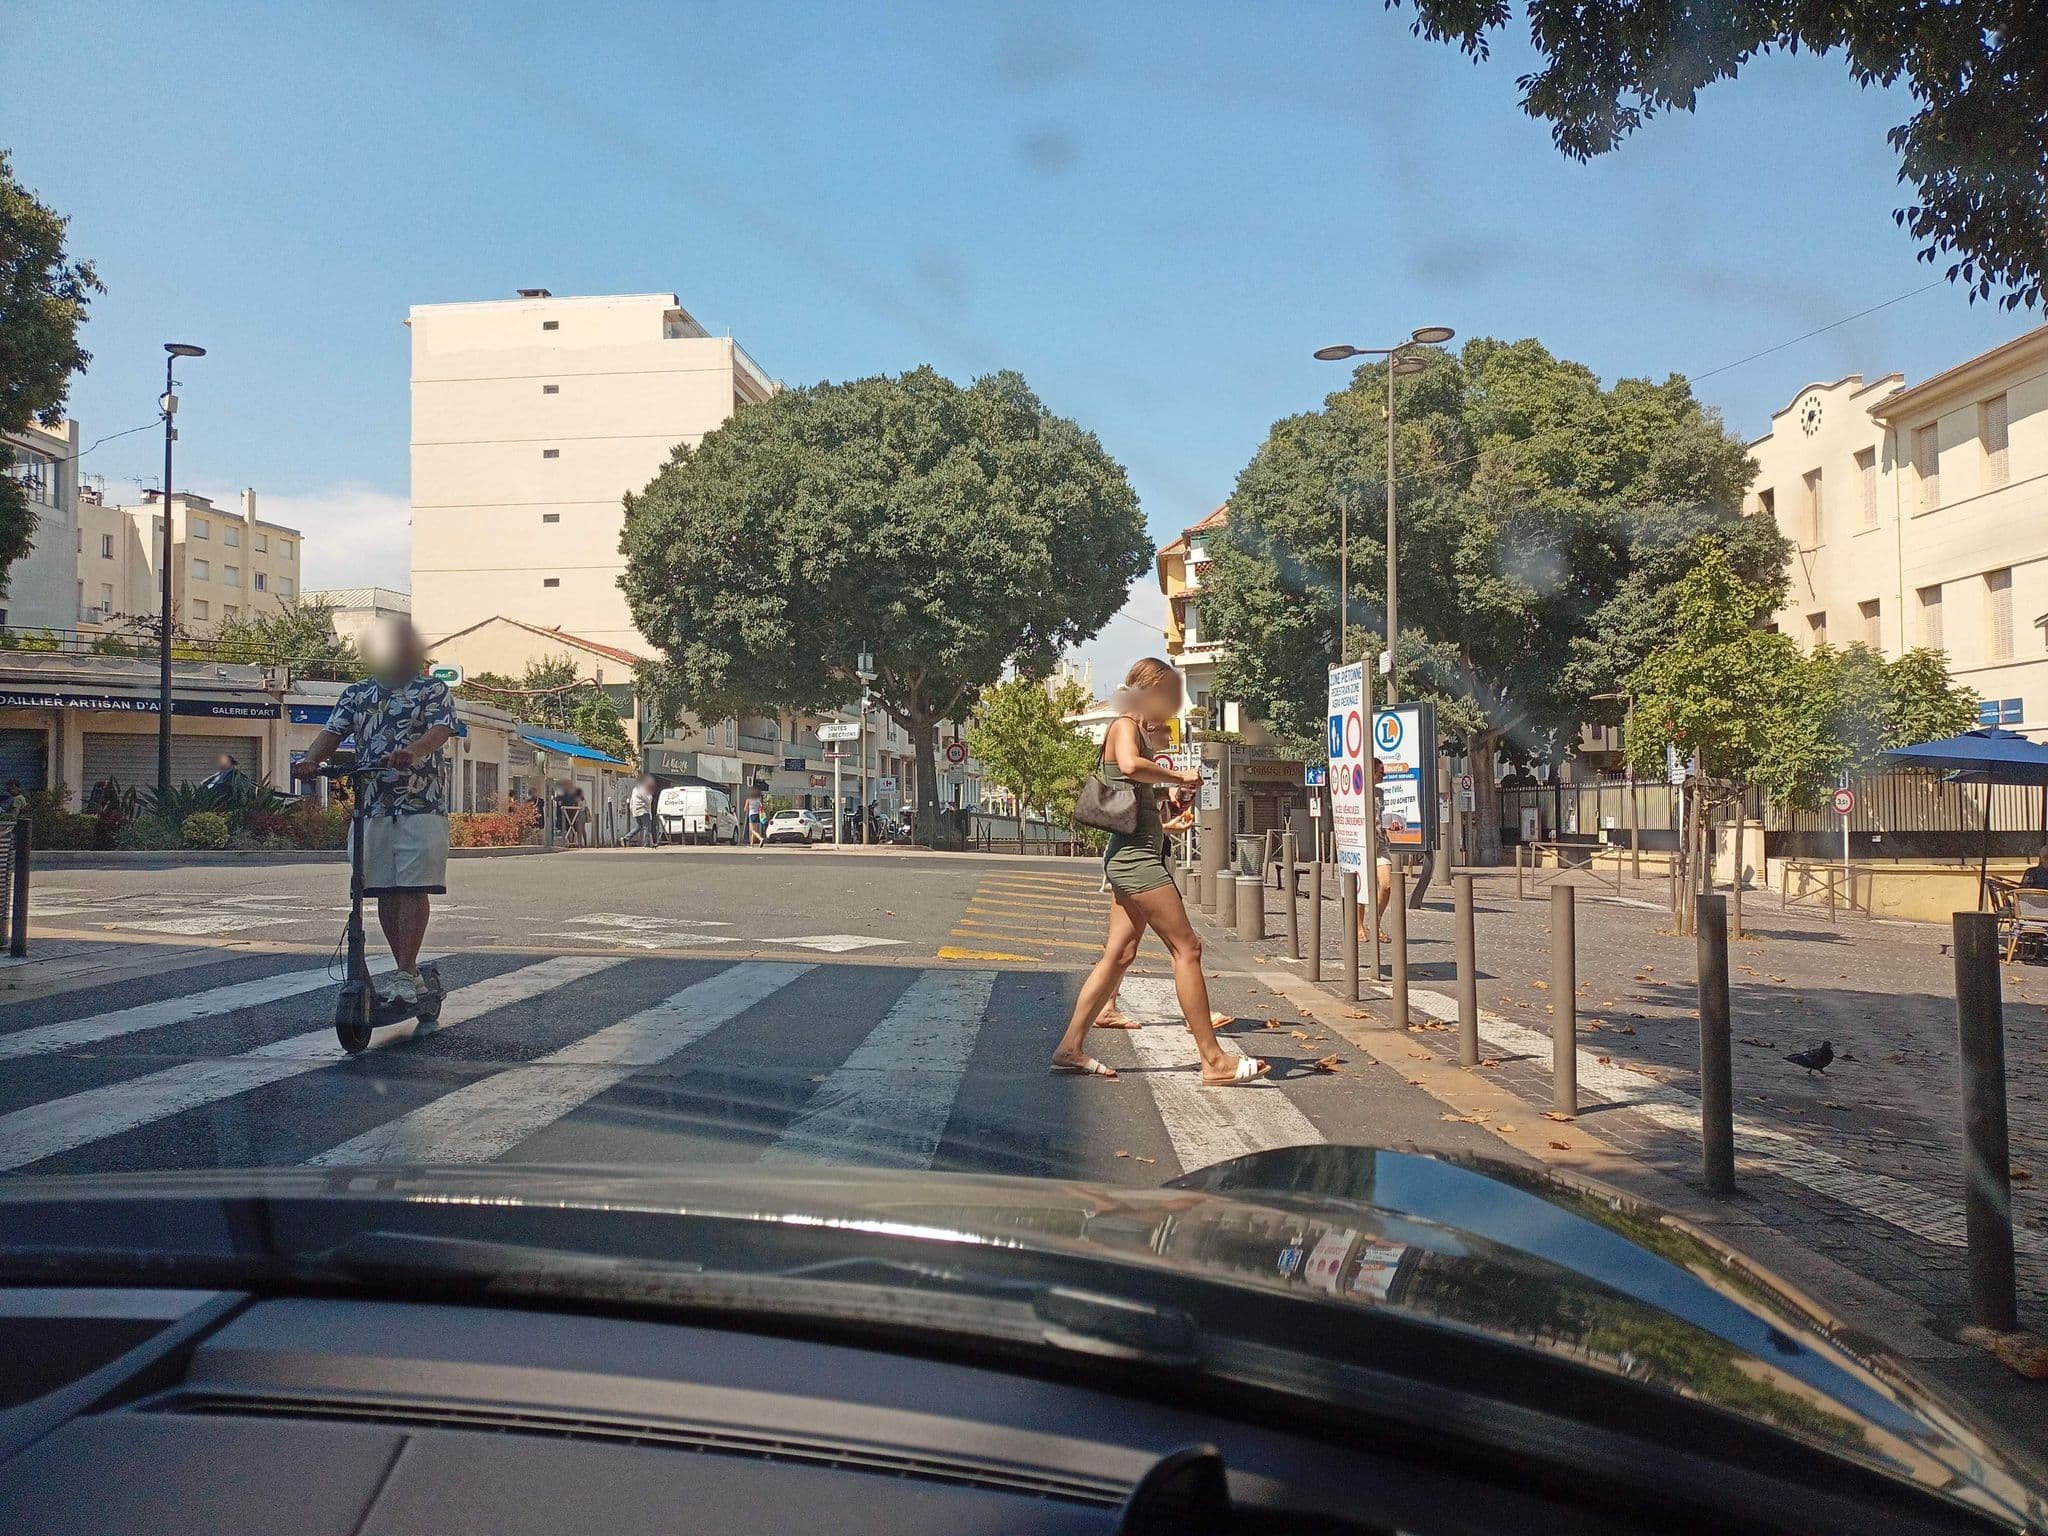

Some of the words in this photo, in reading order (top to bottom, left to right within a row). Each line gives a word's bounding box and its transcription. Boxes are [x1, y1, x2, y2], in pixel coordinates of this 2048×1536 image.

[70, 699, 131, 710] ARTISAN
[136, 701, 175, 711] D'AT
[212, 707, 248, 716] GALERIE
[250, 708, 275, 716] D'ART
[827, 731, 856, 739] DIRECTIONS
